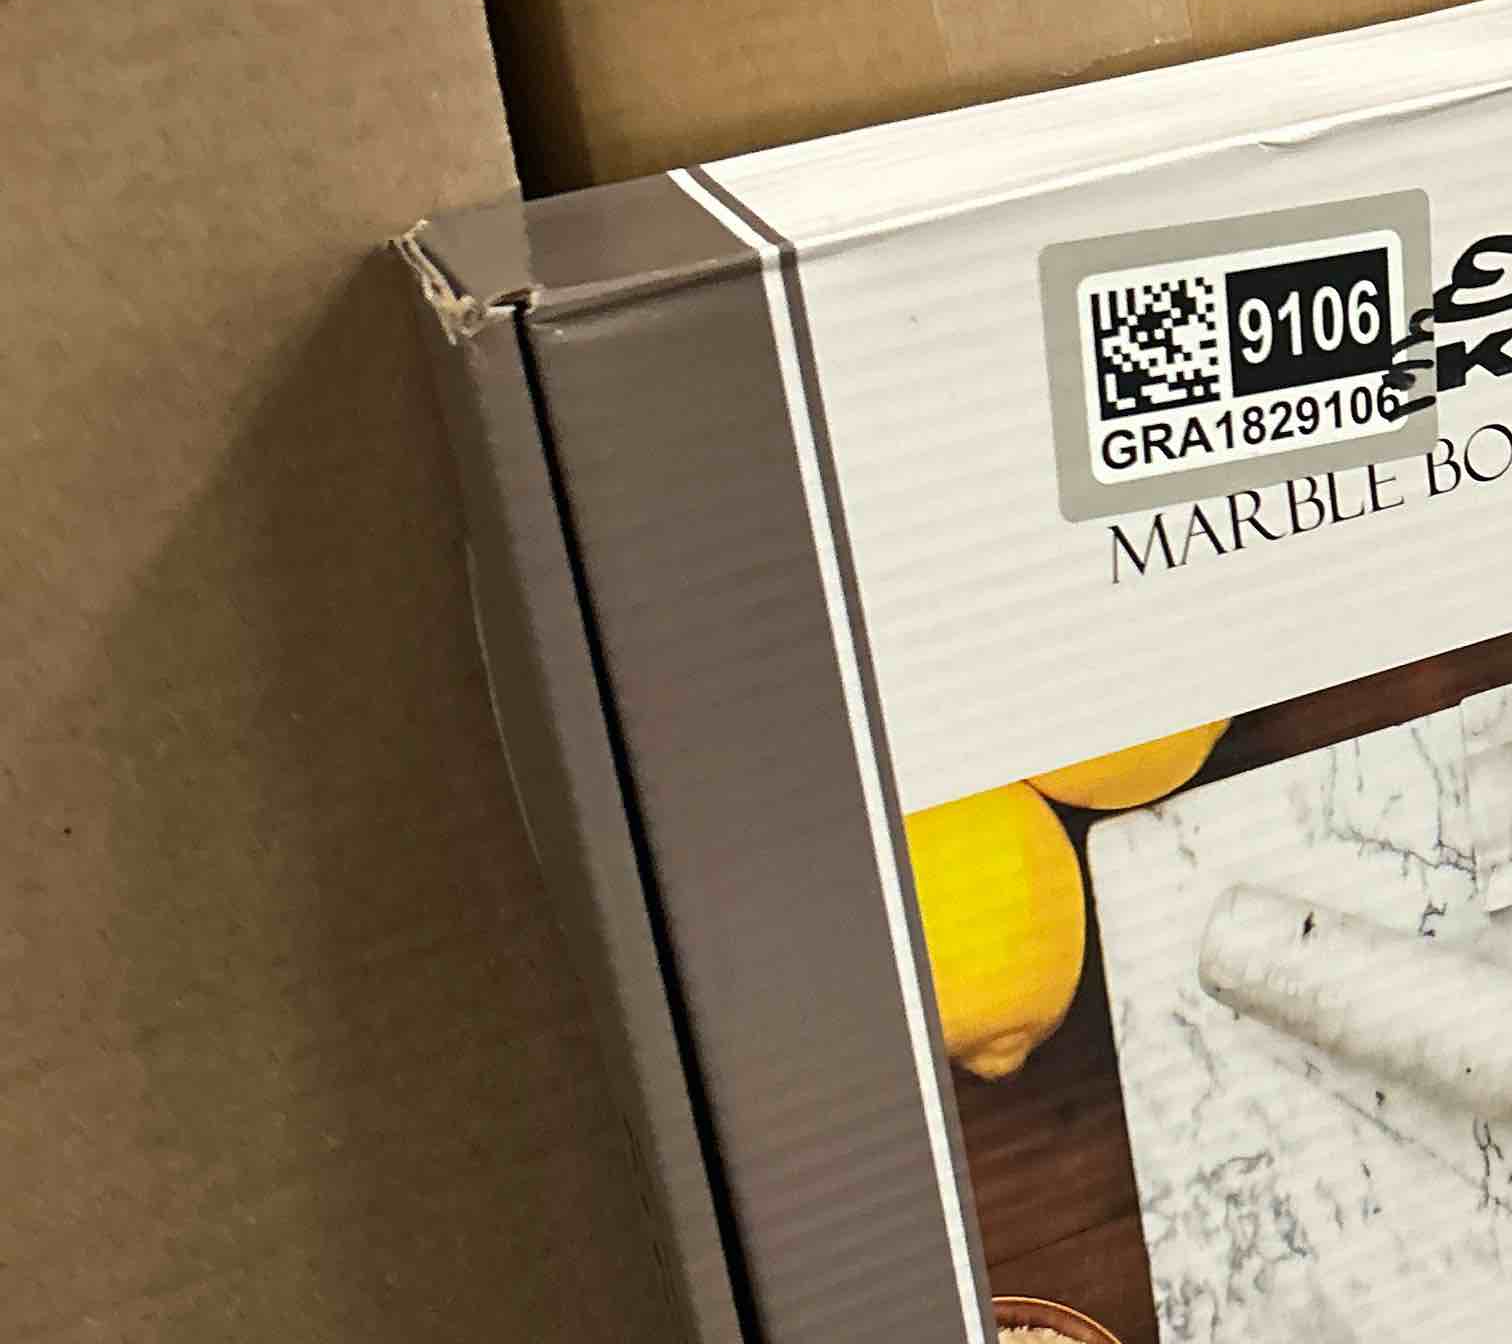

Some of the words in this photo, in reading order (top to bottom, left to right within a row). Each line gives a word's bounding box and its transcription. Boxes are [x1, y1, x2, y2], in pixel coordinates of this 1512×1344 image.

[1237, 279, 1381, 365] 9106
[1101, 380, 1401, 471] GRA1829106
[1107, 463, 1406, 585] MARBLE
